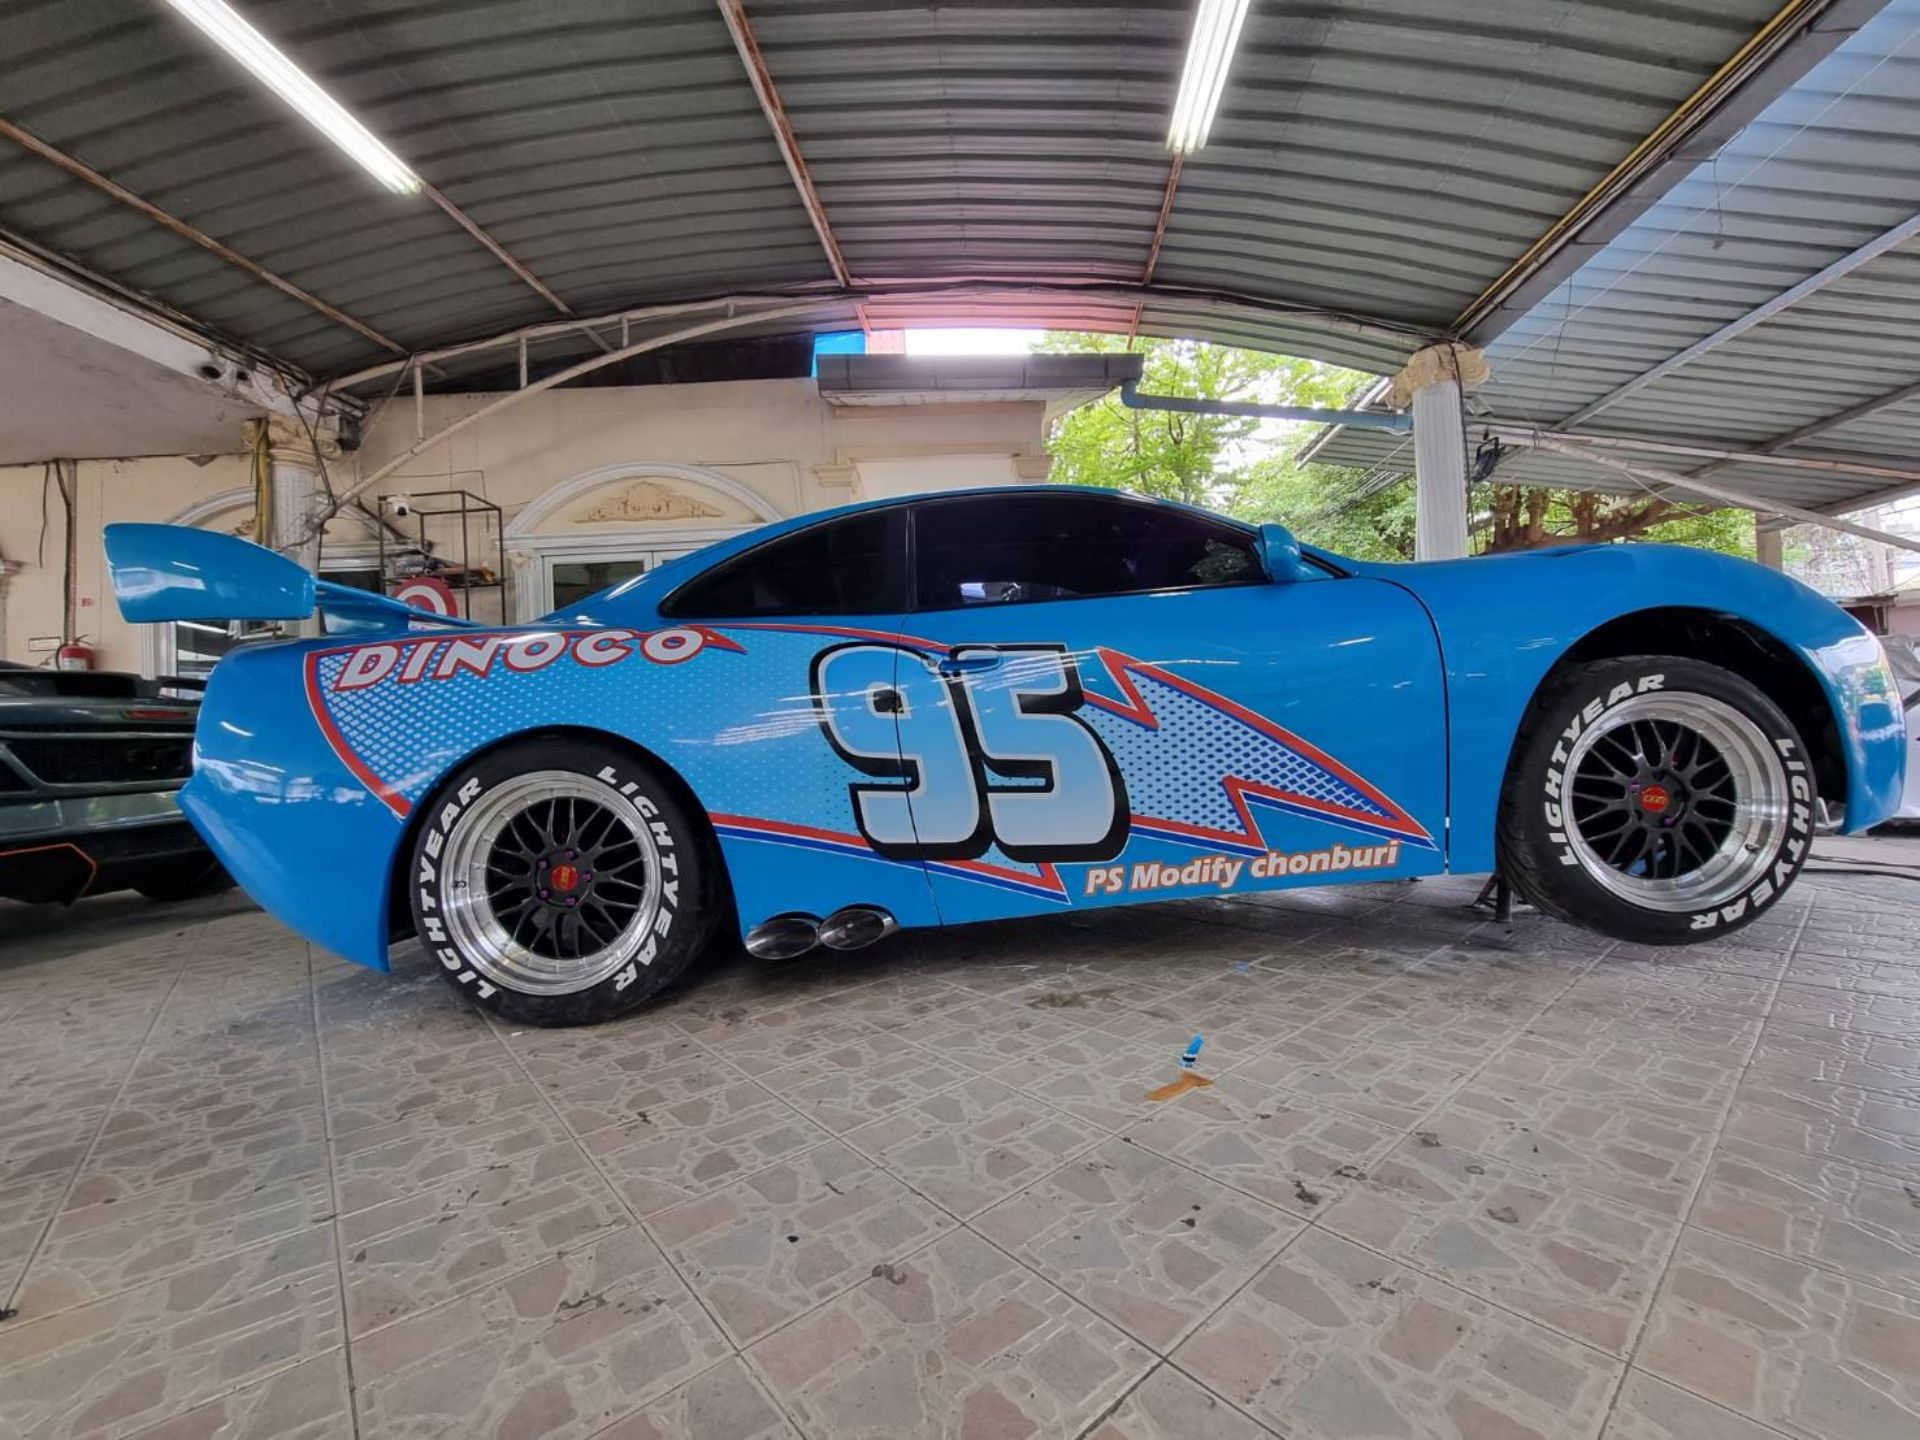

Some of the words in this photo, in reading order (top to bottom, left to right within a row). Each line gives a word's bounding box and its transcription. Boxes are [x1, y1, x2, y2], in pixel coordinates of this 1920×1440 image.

[335, 628, 706, 691] DINOCO
[809, 640, 1131, 864] 95
[1085, 867, 1124, 894] PS
[1130, 856, 1244, 888] Modify
[1250, 839, 1400, 878] chonburi
[1544, 673, 1665, 867] LIGHTYEAR
[1690, 738, 1811, 930] LIGHTYEAR
[419, 777, 498, 999] LIGHTYEAR
[597, 766, 678, 992] LIGHTYEAR
